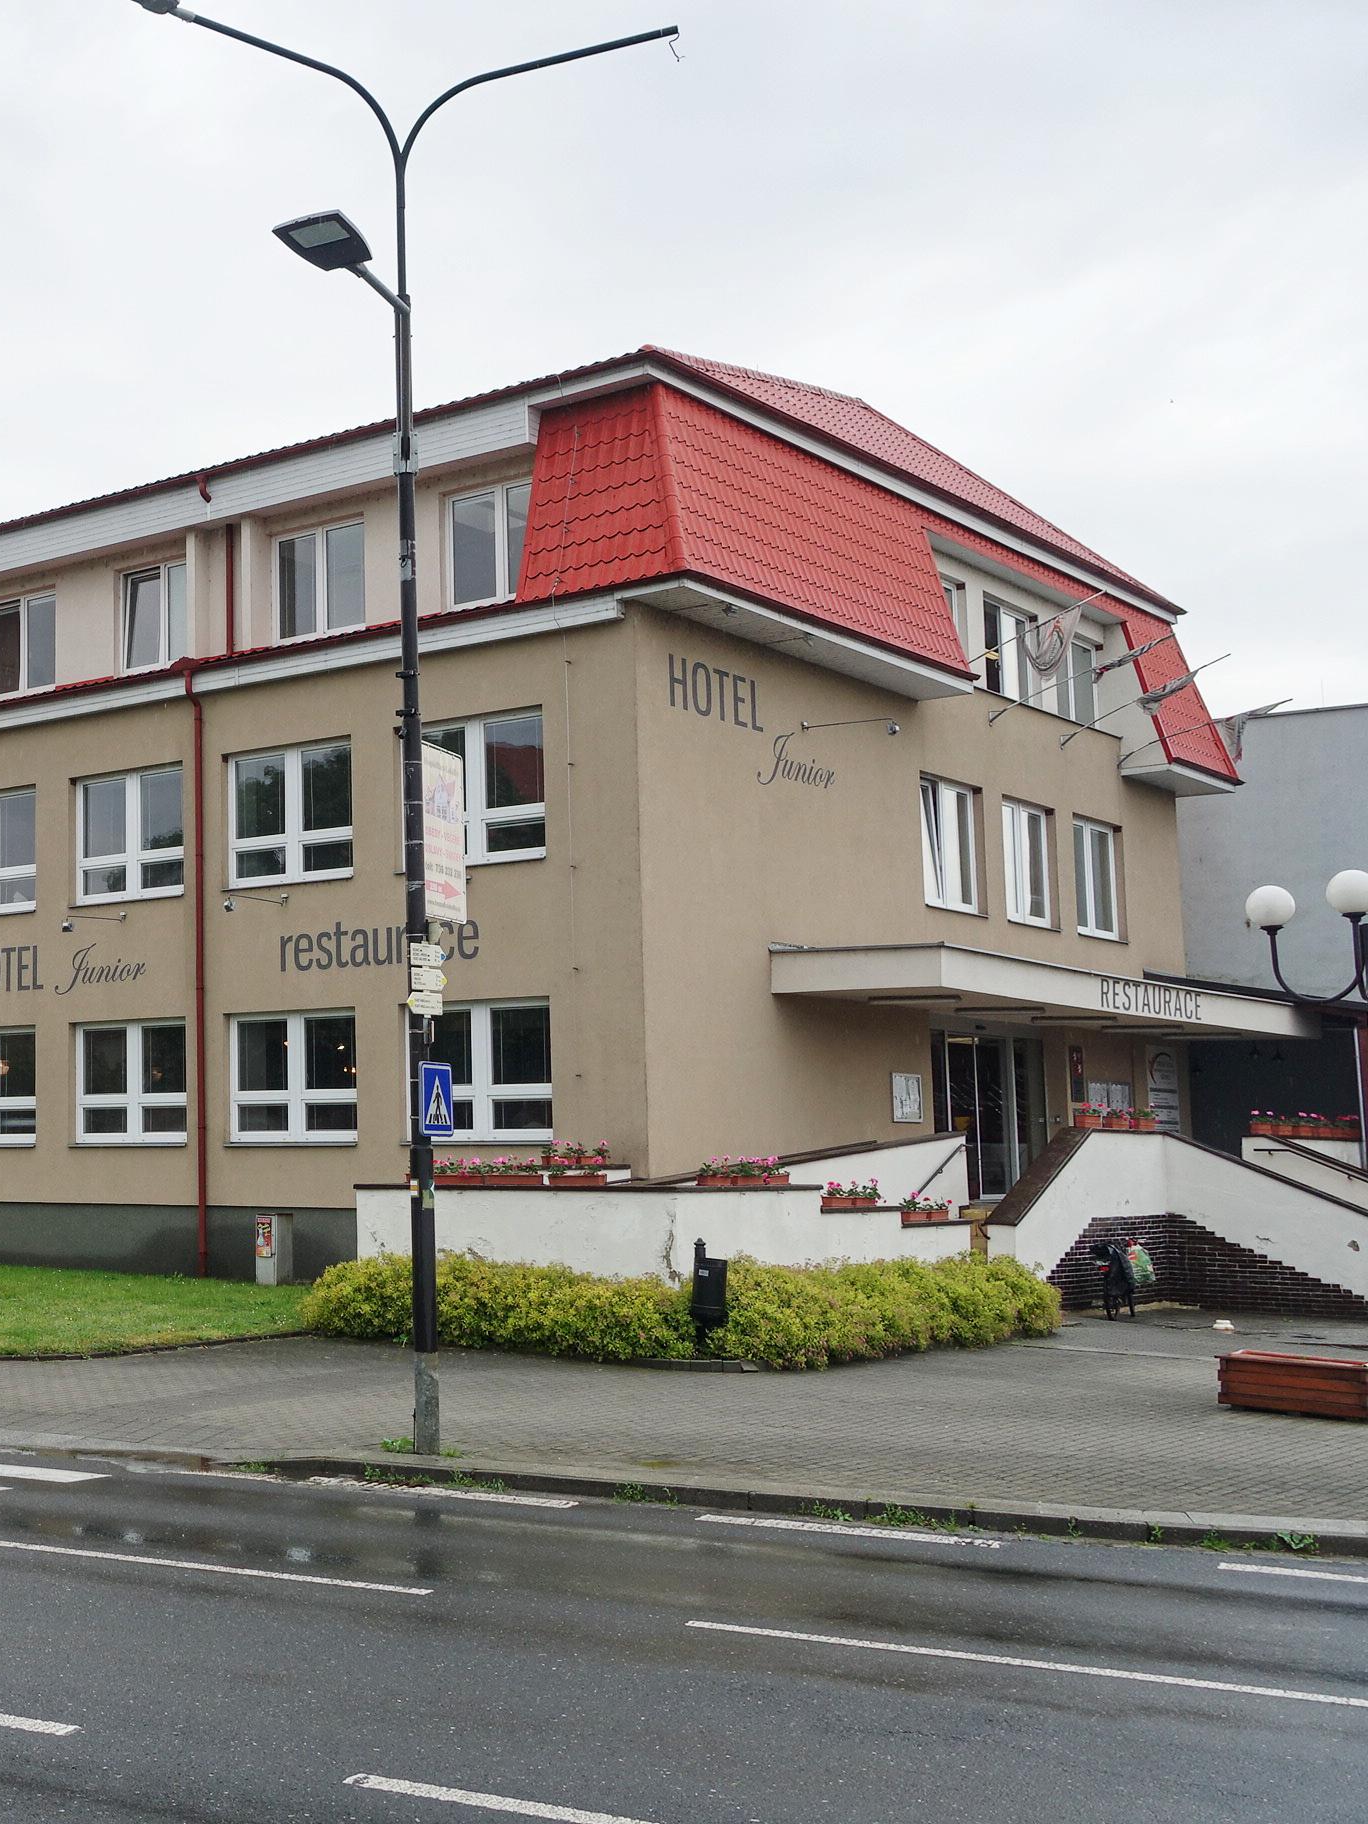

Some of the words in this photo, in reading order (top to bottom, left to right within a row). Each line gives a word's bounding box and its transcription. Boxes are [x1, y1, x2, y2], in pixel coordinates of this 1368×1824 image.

[668, 653, 764, 732] HOTEL
[757, 732, 836, 789] Junior
[54, 943, 146, 995] Junior
[280, 918, 479, 972] restaurce
[1100, 978, 1202, 1020] RESTAURACE
